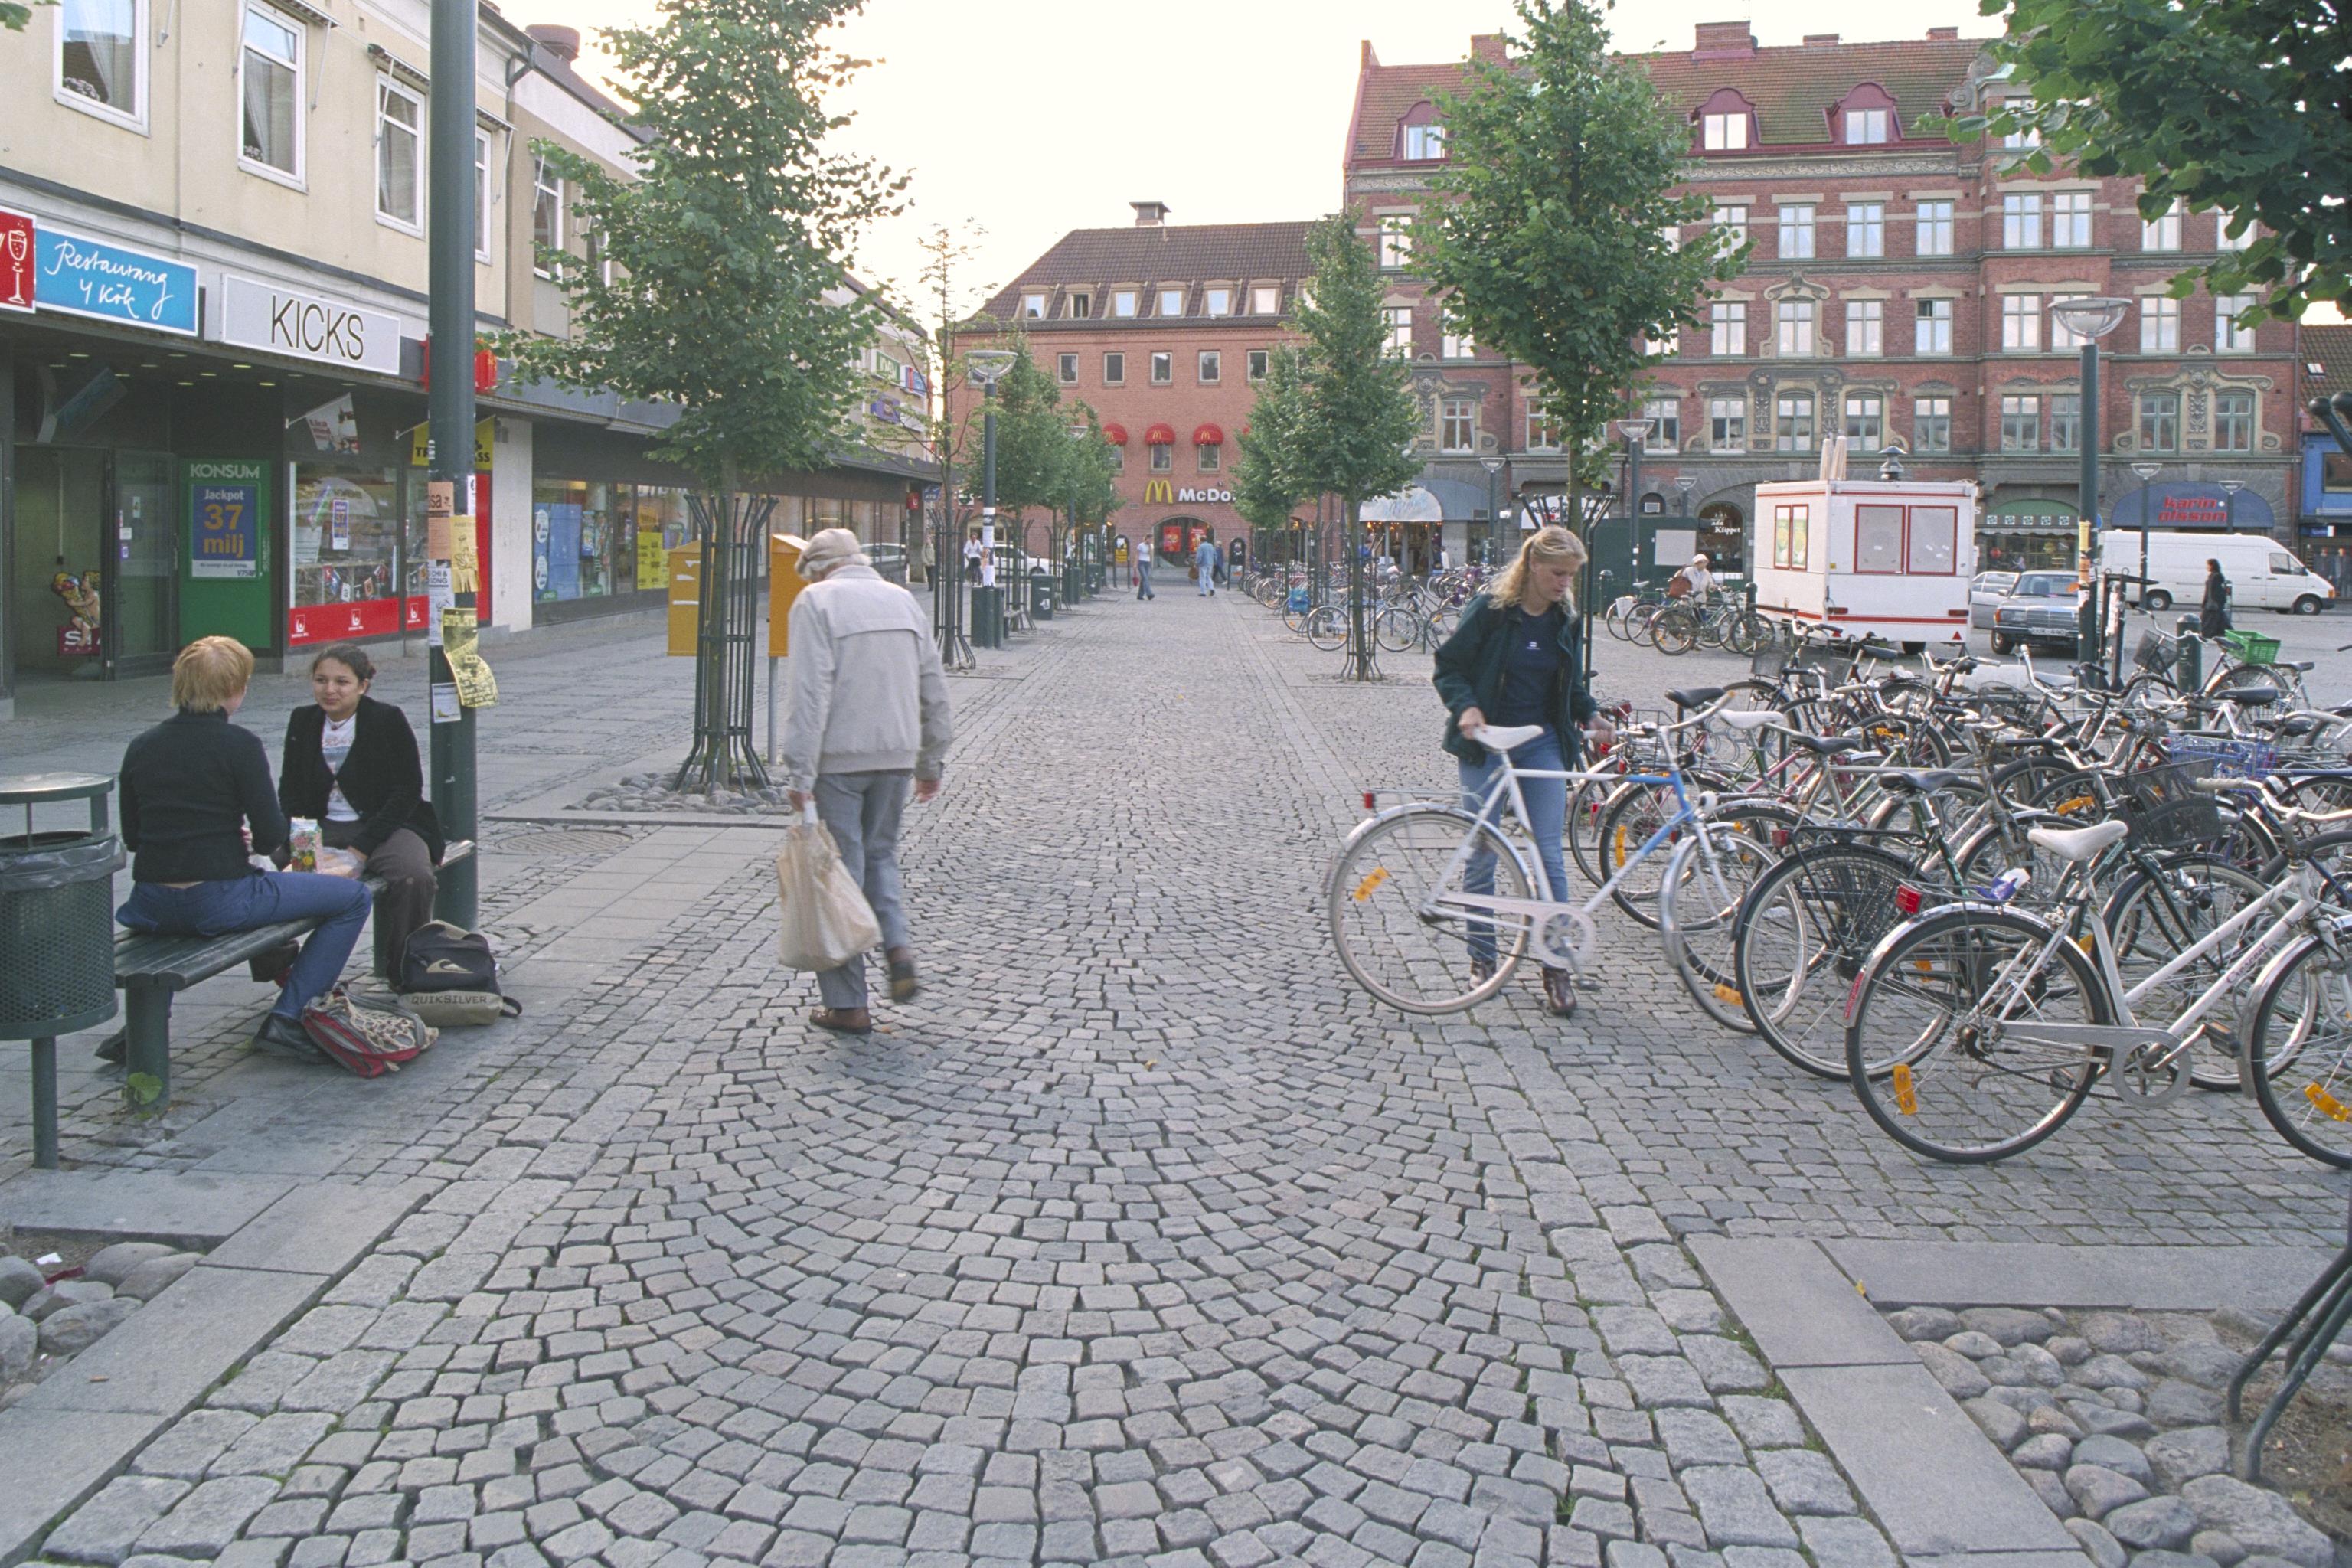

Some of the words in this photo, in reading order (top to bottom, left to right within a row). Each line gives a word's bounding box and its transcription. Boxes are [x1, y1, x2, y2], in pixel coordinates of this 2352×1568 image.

[45, 240, 174, 320] Restaurang
[271, 295, 364, 361] KICKS
[190, 463, 260, 479] KONSUM
[204, 489, 244, 501] Jackpot
[1178, 488, 1236, 502] McDo
[204, 503, 243, 530] 37
[1715, 526, 1740, 535] Klippet
[204, 534, 244, 559] milj
[411, 995, 488, 1005] QUIKSILVER
